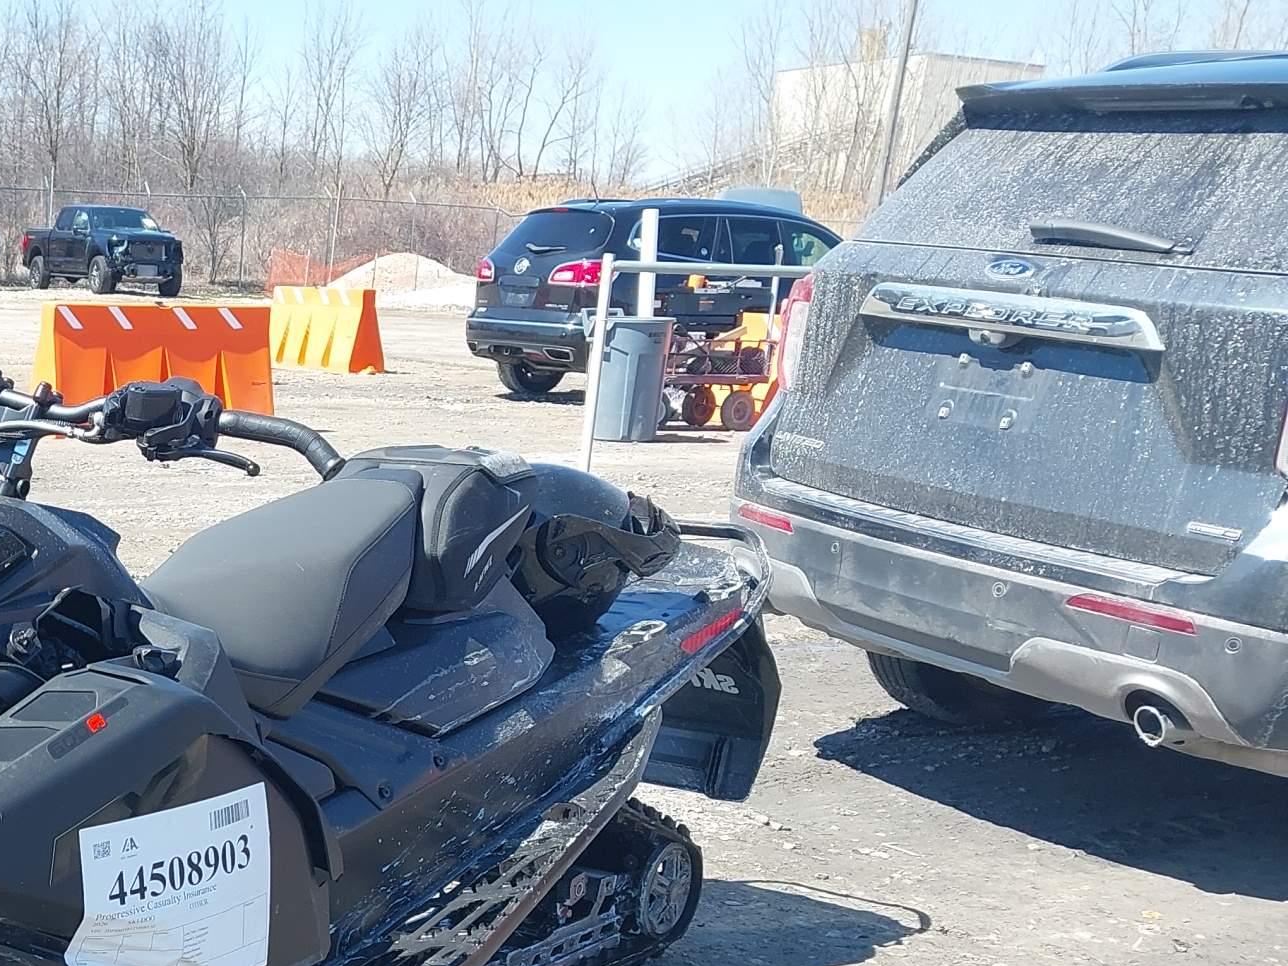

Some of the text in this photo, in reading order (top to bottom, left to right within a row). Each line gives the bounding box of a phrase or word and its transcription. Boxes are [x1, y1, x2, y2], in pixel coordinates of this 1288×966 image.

[897, 296, 1094, 331] EXPLORER
[108, 834, 251, 906] 44508903
[95, 884, 217, 922] Progressive Casualty Insurance
